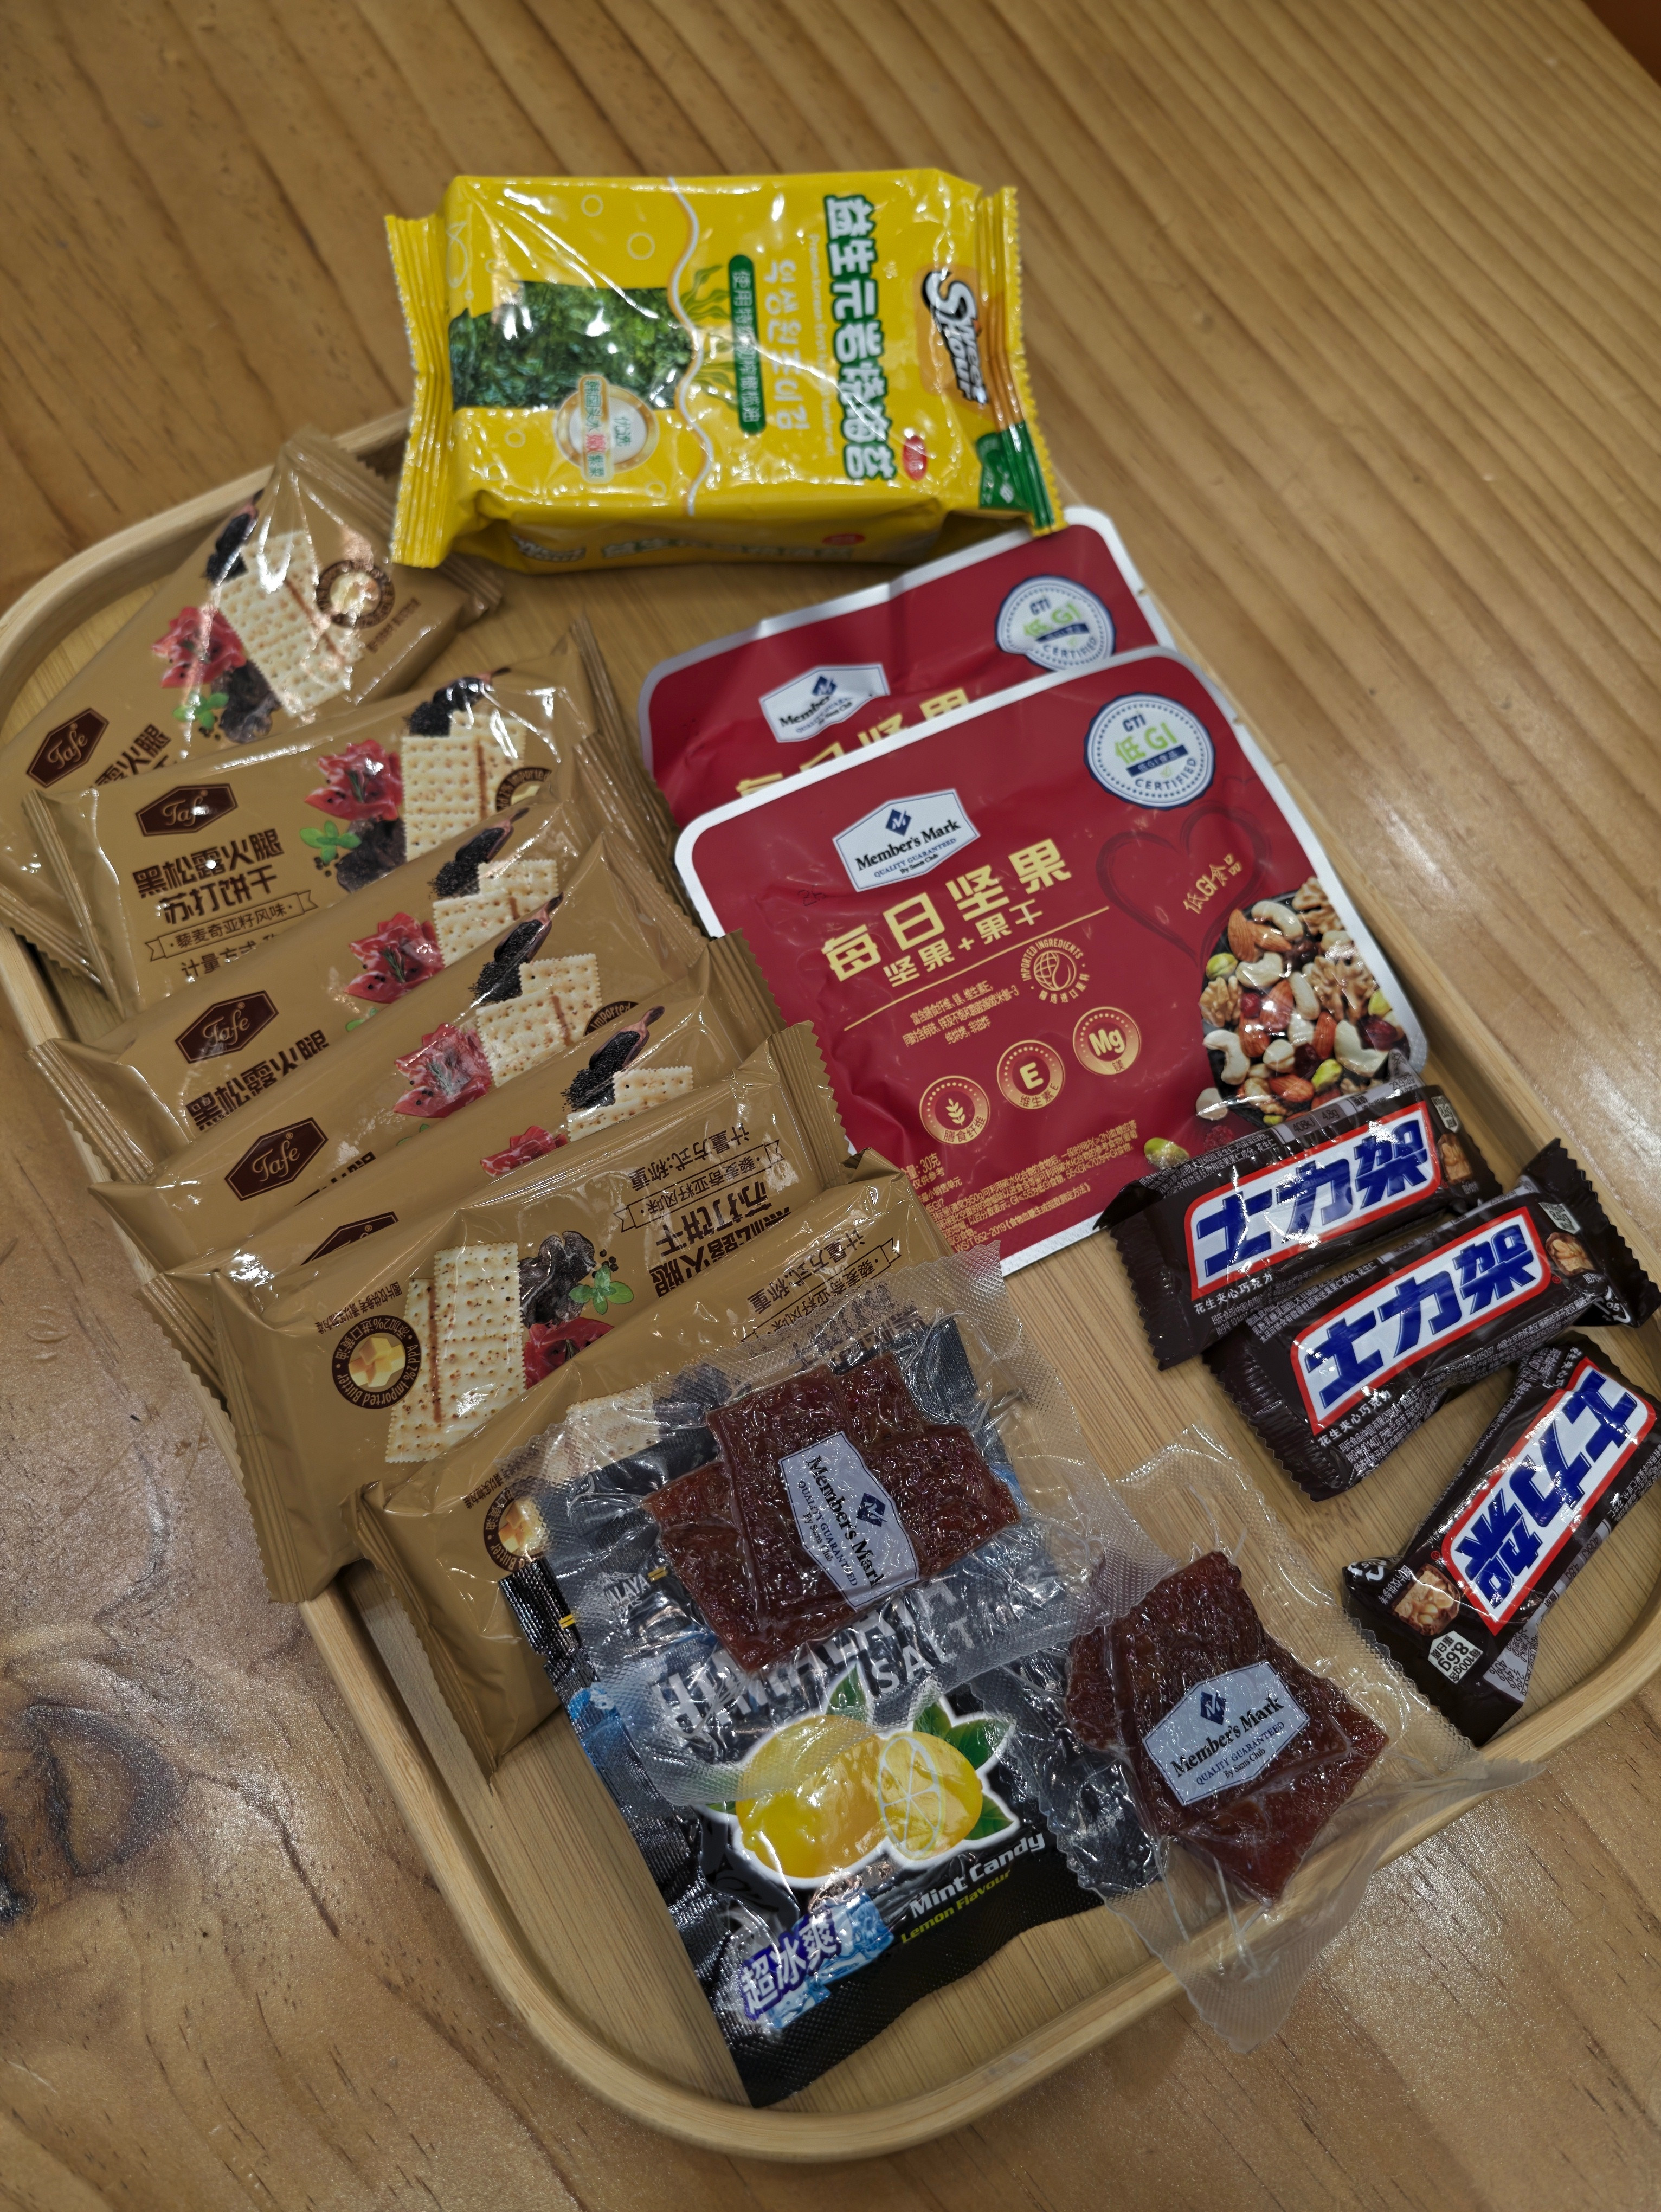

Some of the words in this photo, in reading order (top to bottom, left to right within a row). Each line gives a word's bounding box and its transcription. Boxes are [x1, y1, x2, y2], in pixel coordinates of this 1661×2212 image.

[823, 192, 898, 482] 益生元岩烧海苔
[1122, 713, 1147, 734] CTI
[1135, 757, 1196, 790] CERTIFIED
[163, 790, 210, 828] Taf
[132, 829, 285, 898] 黑松露火腿
[854, 832, 922, 872] Member's
[920, 816, 961, 844] Mark
[873, 860, 906, 879] QUALITY
[907, 837, 957, 864] GUARANTEED
[162, 864, 279, 924] 苏打饼干
[822, 838, 1072, 982] 每日坚果
[1020, 946, 1038, 981] IMPORTED
[1035, 938, 1084, 959] INGREDIENTS
[1089, 1030, 1125, 1056] Mg
[185, 1030, 329, 1130] 黑松露火腿
[1019, 1062, 1044, 1089] E
[943, 1115, 987, 1143] 膳食纤维
[1321, 1107, 1341, 1123] 4.8g
[1256, 1137, 1277, 1153] 花生仁
[649, 1180, 775, 1257] 苏打饼干
[1196, 1119, 1428, 1279] 士力架
[1357, 1261, 1377, 1277] 花生仁
[1193, 1271, 1274, 1316] 花生夹心巧克力
[1303, 1225, 1536, 1410] 士力架
[403, 1365, 417, 1380] 2%
[406, 1344, 420, 1362] Add
[336, 1372, 363, 1401] Butter
[361, 1380, 407, 1406] Imported
[1317, 1390, 1392, 1448] 花生夹心巧克力
[796, 1479, 825, 1523] QUALITY
[805, 1455, 858, 1541] Member's
[1455, 1370, 1638, 1608] 士力架
[868, 1615, 981, 1695] SALT
[1430, 1633, 1454, 1661] 蛋白质
[1436, 1638, 1469, 1674] 8.6g
[1448, 1645, 1482, 1685] 每100g含
[1169, 1721, 1241, 1777] Member's
[1242, 1696, 1284, 1732] Mark
[1195, 1758, 1230, 1786] QUALITY
[1229, 1721, 1286, 1765] GUARANTEED
[1224, 1767, 1234, 1779] By
[1246, 1747, 1266, 1764] Club
[907, 1883, 969, 1918] Mint
[969, 1831, 1045, 1883] Candy
[900, 1905, 954, 1944] Lemon
[954, 1869, 1012, 1913] Flavour
[742, 1906, 842, 2016] 超冰爽
